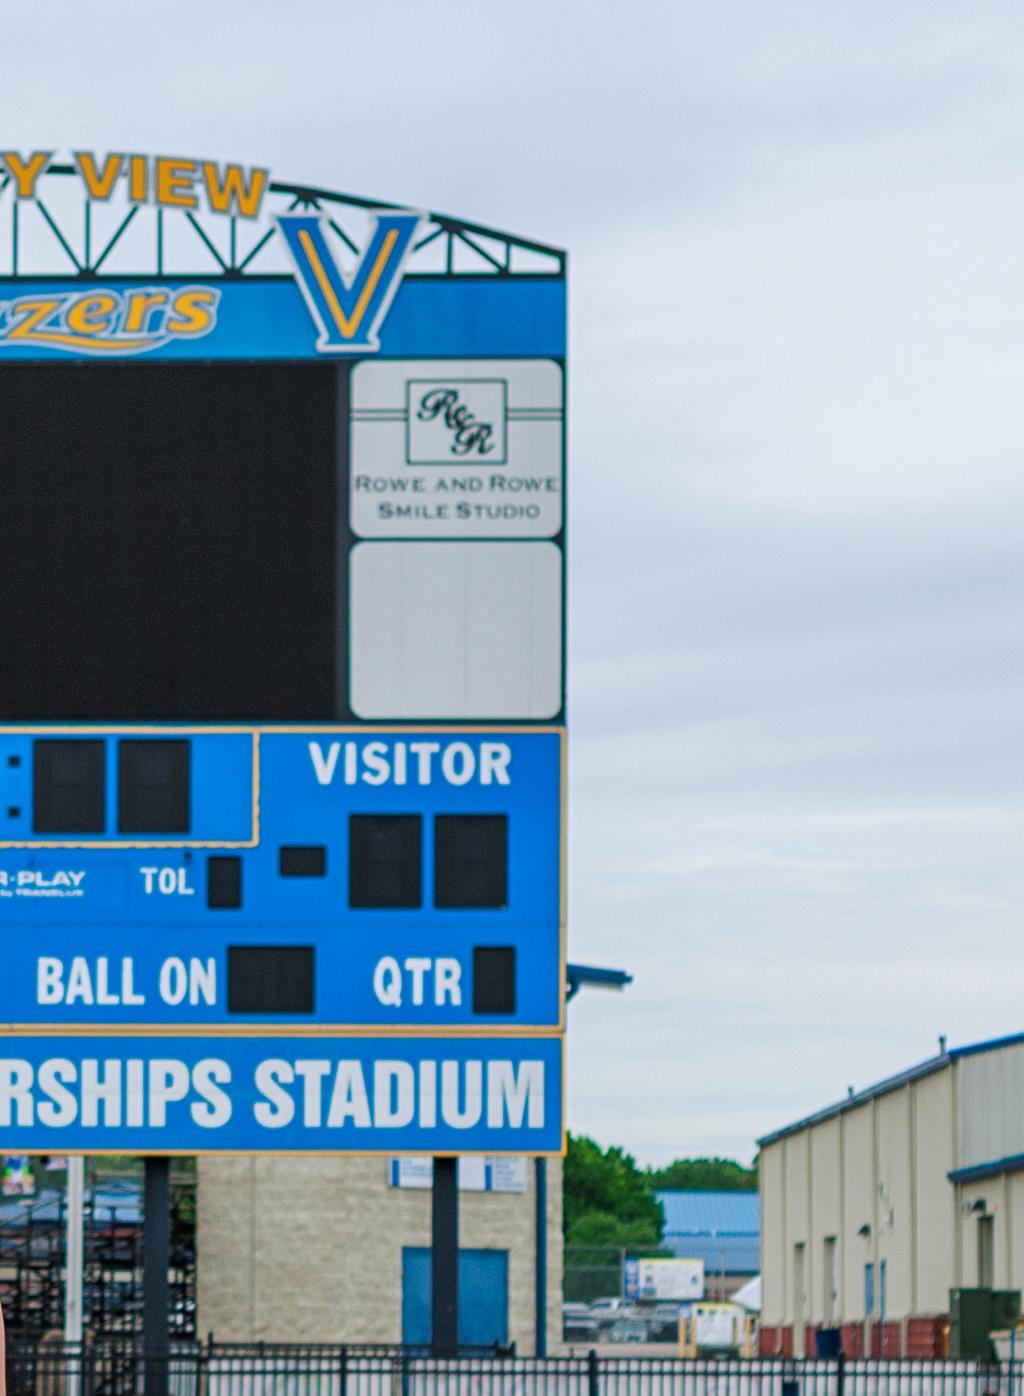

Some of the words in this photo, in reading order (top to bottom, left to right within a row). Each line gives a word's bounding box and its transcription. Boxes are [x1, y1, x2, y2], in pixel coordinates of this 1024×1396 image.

[73, 151, 269, 219] VIEW
[273, 210, 429, 353] V
[308, 741, 512, 786] VISITOR
[139, 867, 195, 896] TOL
[36, 956, 145, 1005] BALL
[159, 956, 217, 1005] ON
[372, 956, 462, 1008] QTR
[253, 1058, 546, 1130] STADIUM
